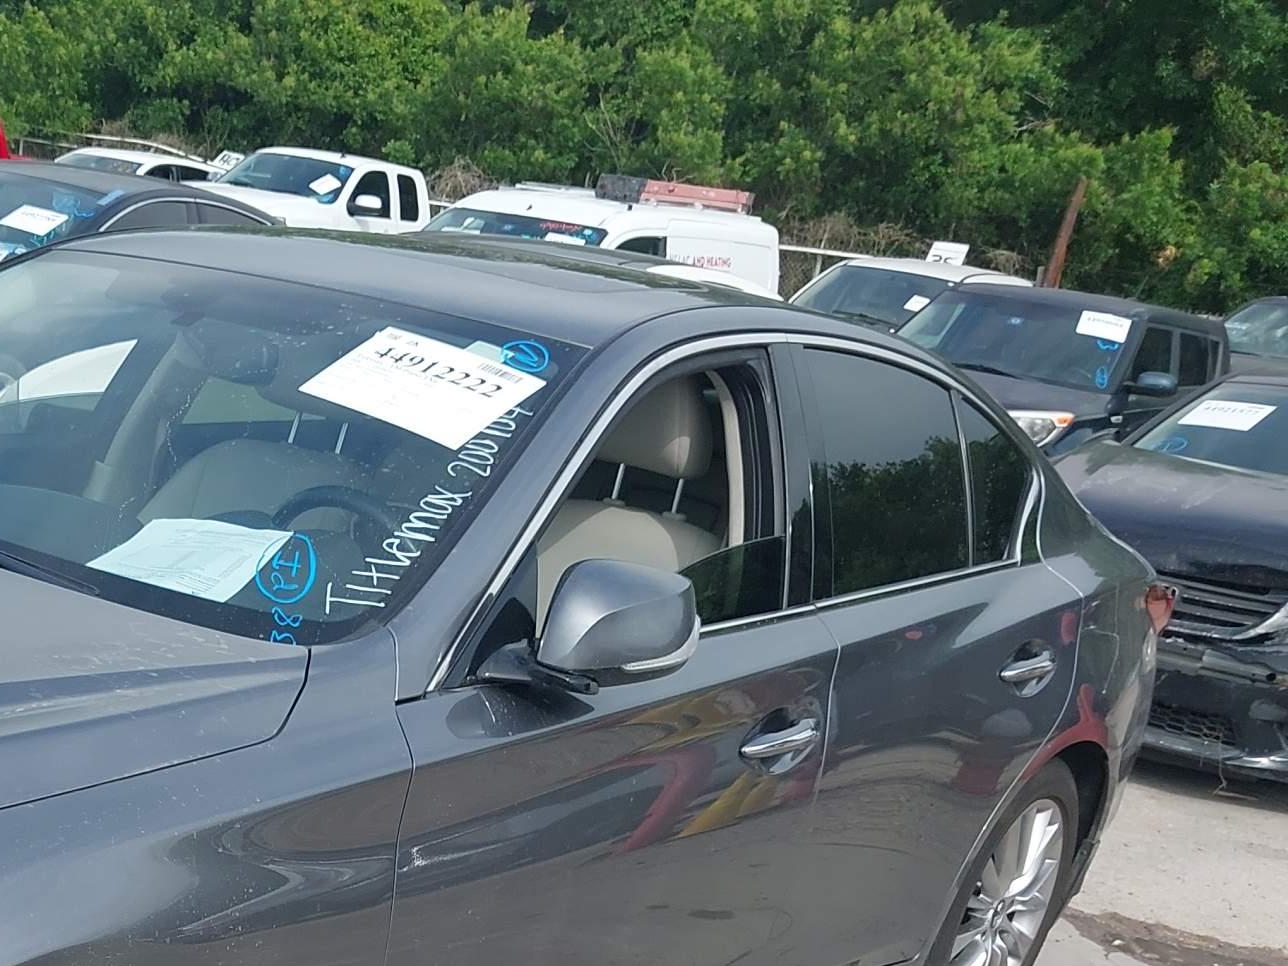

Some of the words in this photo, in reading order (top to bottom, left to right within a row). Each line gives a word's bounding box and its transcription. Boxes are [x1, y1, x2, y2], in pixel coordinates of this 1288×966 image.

[692, 256, 705, 269] AND
[706, 256, 732, 269] HEATING
[374, 346, 503, 399] 44912222
